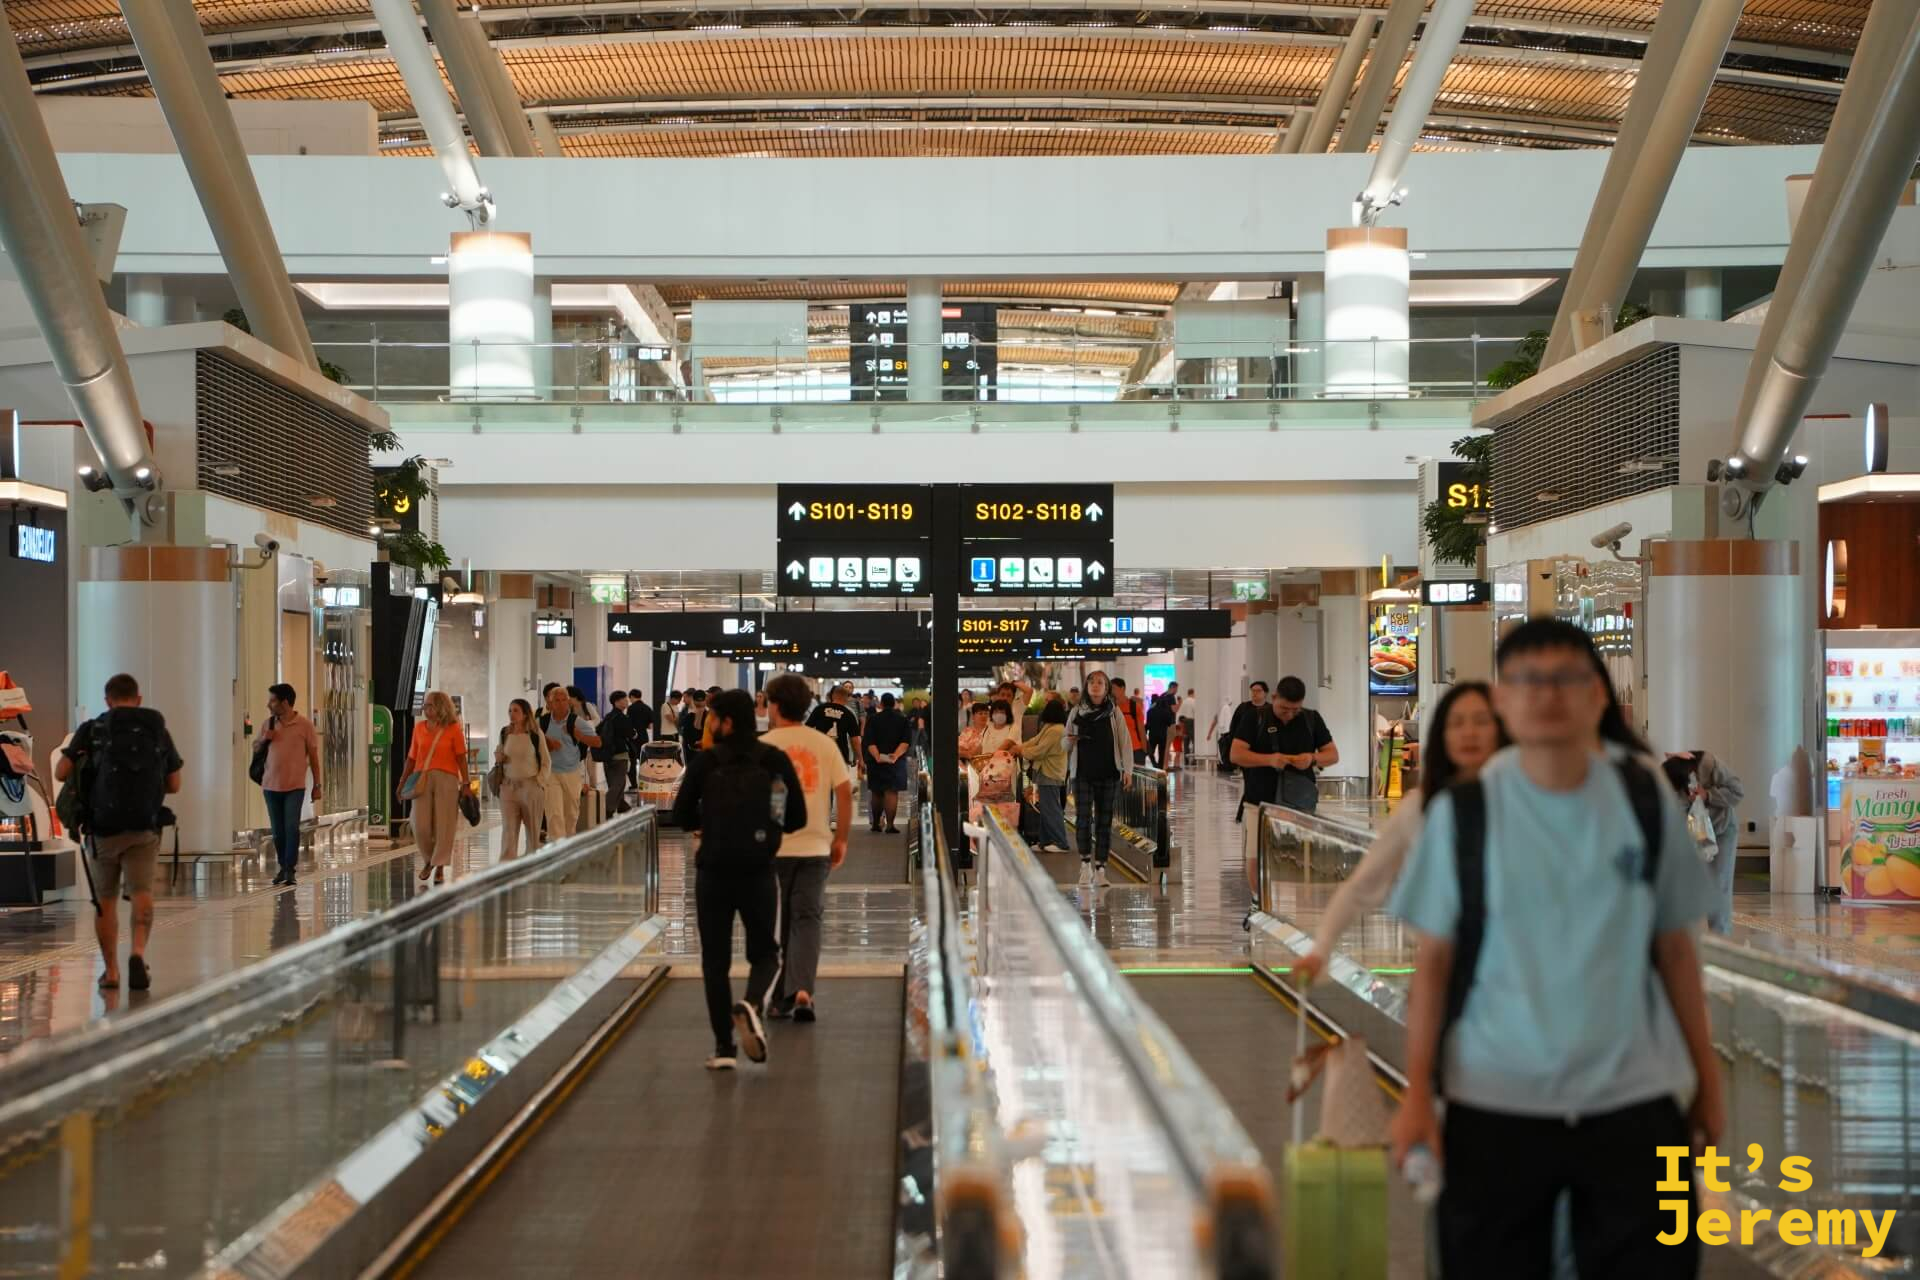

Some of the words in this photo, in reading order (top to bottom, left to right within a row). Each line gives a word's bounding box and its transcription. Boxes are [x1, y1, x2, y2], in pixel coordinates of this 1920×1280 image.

[810, 502, 913, 520] S101-S119
[976, 502, 1082, 520] S102-S118
[612, 622, 632, 634] 4FL
[962, 619, 1030, 632] S101-S117
[1875, 788, 1909, 800] Fresh
